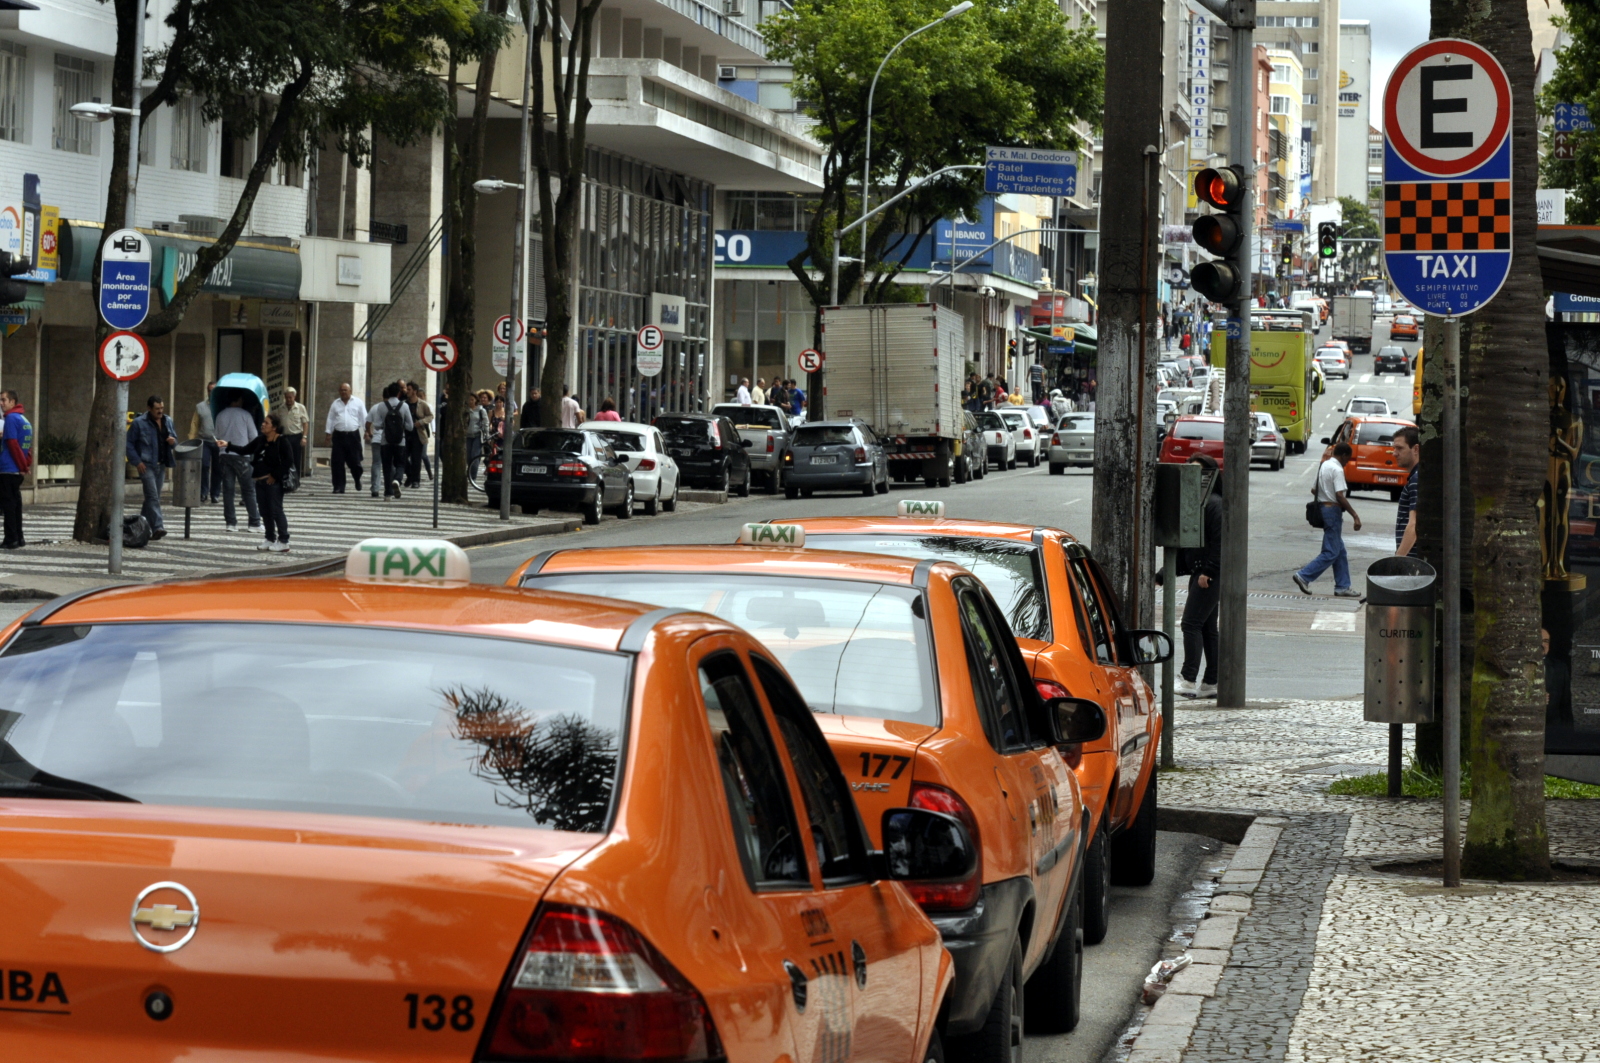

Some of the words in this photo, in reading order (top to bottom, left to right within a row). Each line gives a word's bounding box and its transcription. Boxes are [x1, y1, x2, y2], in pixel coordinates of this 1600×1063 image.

[1195, 16, 1206, 77] AFAMIA
[1194, 86, 1205, 137] HOTEL
[1420, 64, 1473, 149] E
[1570, 106, 1589, 116] Sã
[1011, 151, 1028, 160] Mal.
[1031, 152, 1071, 162] Deodoro
[998, 163, 1023, 172] Batel
[997, 173, 1015, 182] Rua
[1017, 174, 1033, 183] das
[1035, 175, 1064, 185] Flores
[997, 183, 1010, 192] Pç.
[1013, 183, 1062, 194] Tiradentes
[1415, 255, 1476, 278] TAXI
[116, 272, 135, 281] Área
[102, 283, 148, 291] monitorada
[117, 294, 132, 302] por
[107, 301, 142, 310] câmeras
[645, 330, 656, 345] E
[432, 342, 448, 365] E
[1250, 350, 1280, 358] urismo
[904, 501, 939, 515] TAXI
[748, 524, 795, 543] TAXI
[360, 545, 447, 577] TAXI
[859, 752, 911, 780] 177
[403, 993, 475, 1032] 138
